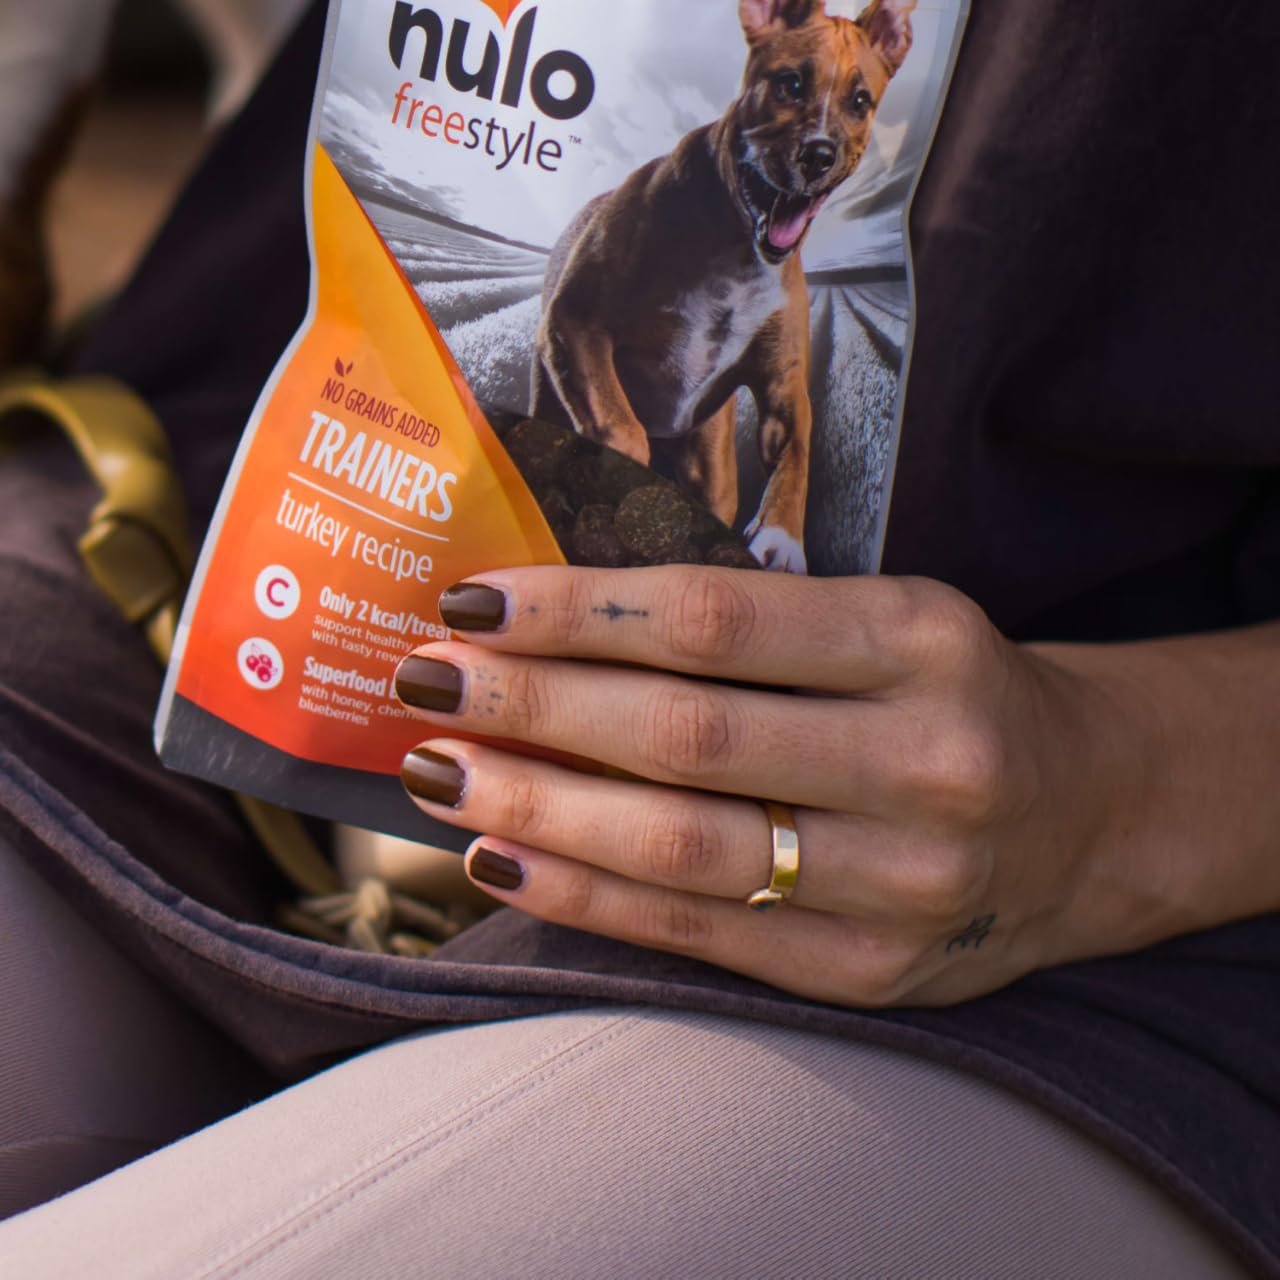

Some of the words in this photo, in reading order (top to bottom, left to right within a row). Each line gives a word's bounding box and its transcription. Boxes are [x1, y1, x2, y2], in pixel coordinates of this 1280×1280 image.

[388, 0, 596, 120] nulo
[391, 82, 563, 172] freestyle
[320, 377, 345, 404] NO
[344, 388, 398, 429] GRAINS
[395, 412, 441, 448] ADDED
[299, 410, 457, 522] TRAINERS
[275, 488, 349, 557] turkey
[351, 530, 433, 584] recipe
[320, 585, 355, 620] Only
[357, 600, 369, 621] 2
[311, 628, 338, 647] with
[341, 638, 373, 658] tasty
[313, 614, 363, 642] support
[365, 630, 414, 653] healthy
[303, 656, 387, 697] Superfood
[298, 696, 370, 727] blueberries
[301, 683, 329, 702] with
[331, 690, 375, 714] honey,
